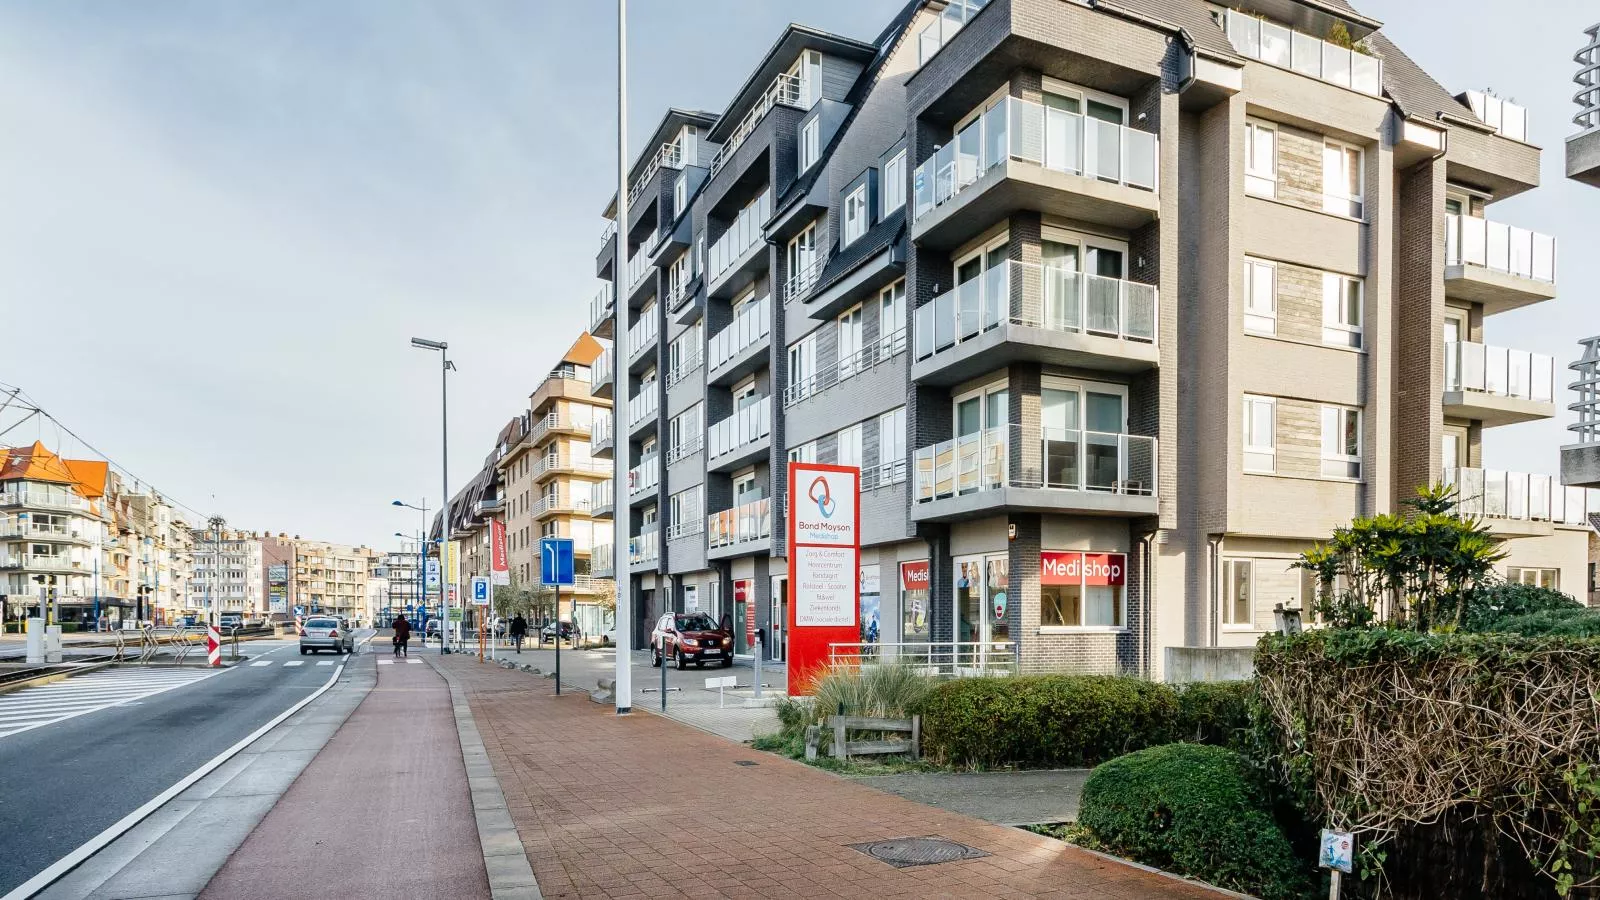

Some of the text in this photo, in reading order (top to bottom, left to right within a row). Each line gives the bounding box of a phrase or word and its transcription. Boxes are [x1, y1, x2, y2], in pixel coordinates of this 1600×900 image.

[798, 521, 820, 530] Bond
[1043, 558, 1121, 582] Medishop
[477, 583, 484, 592] P
